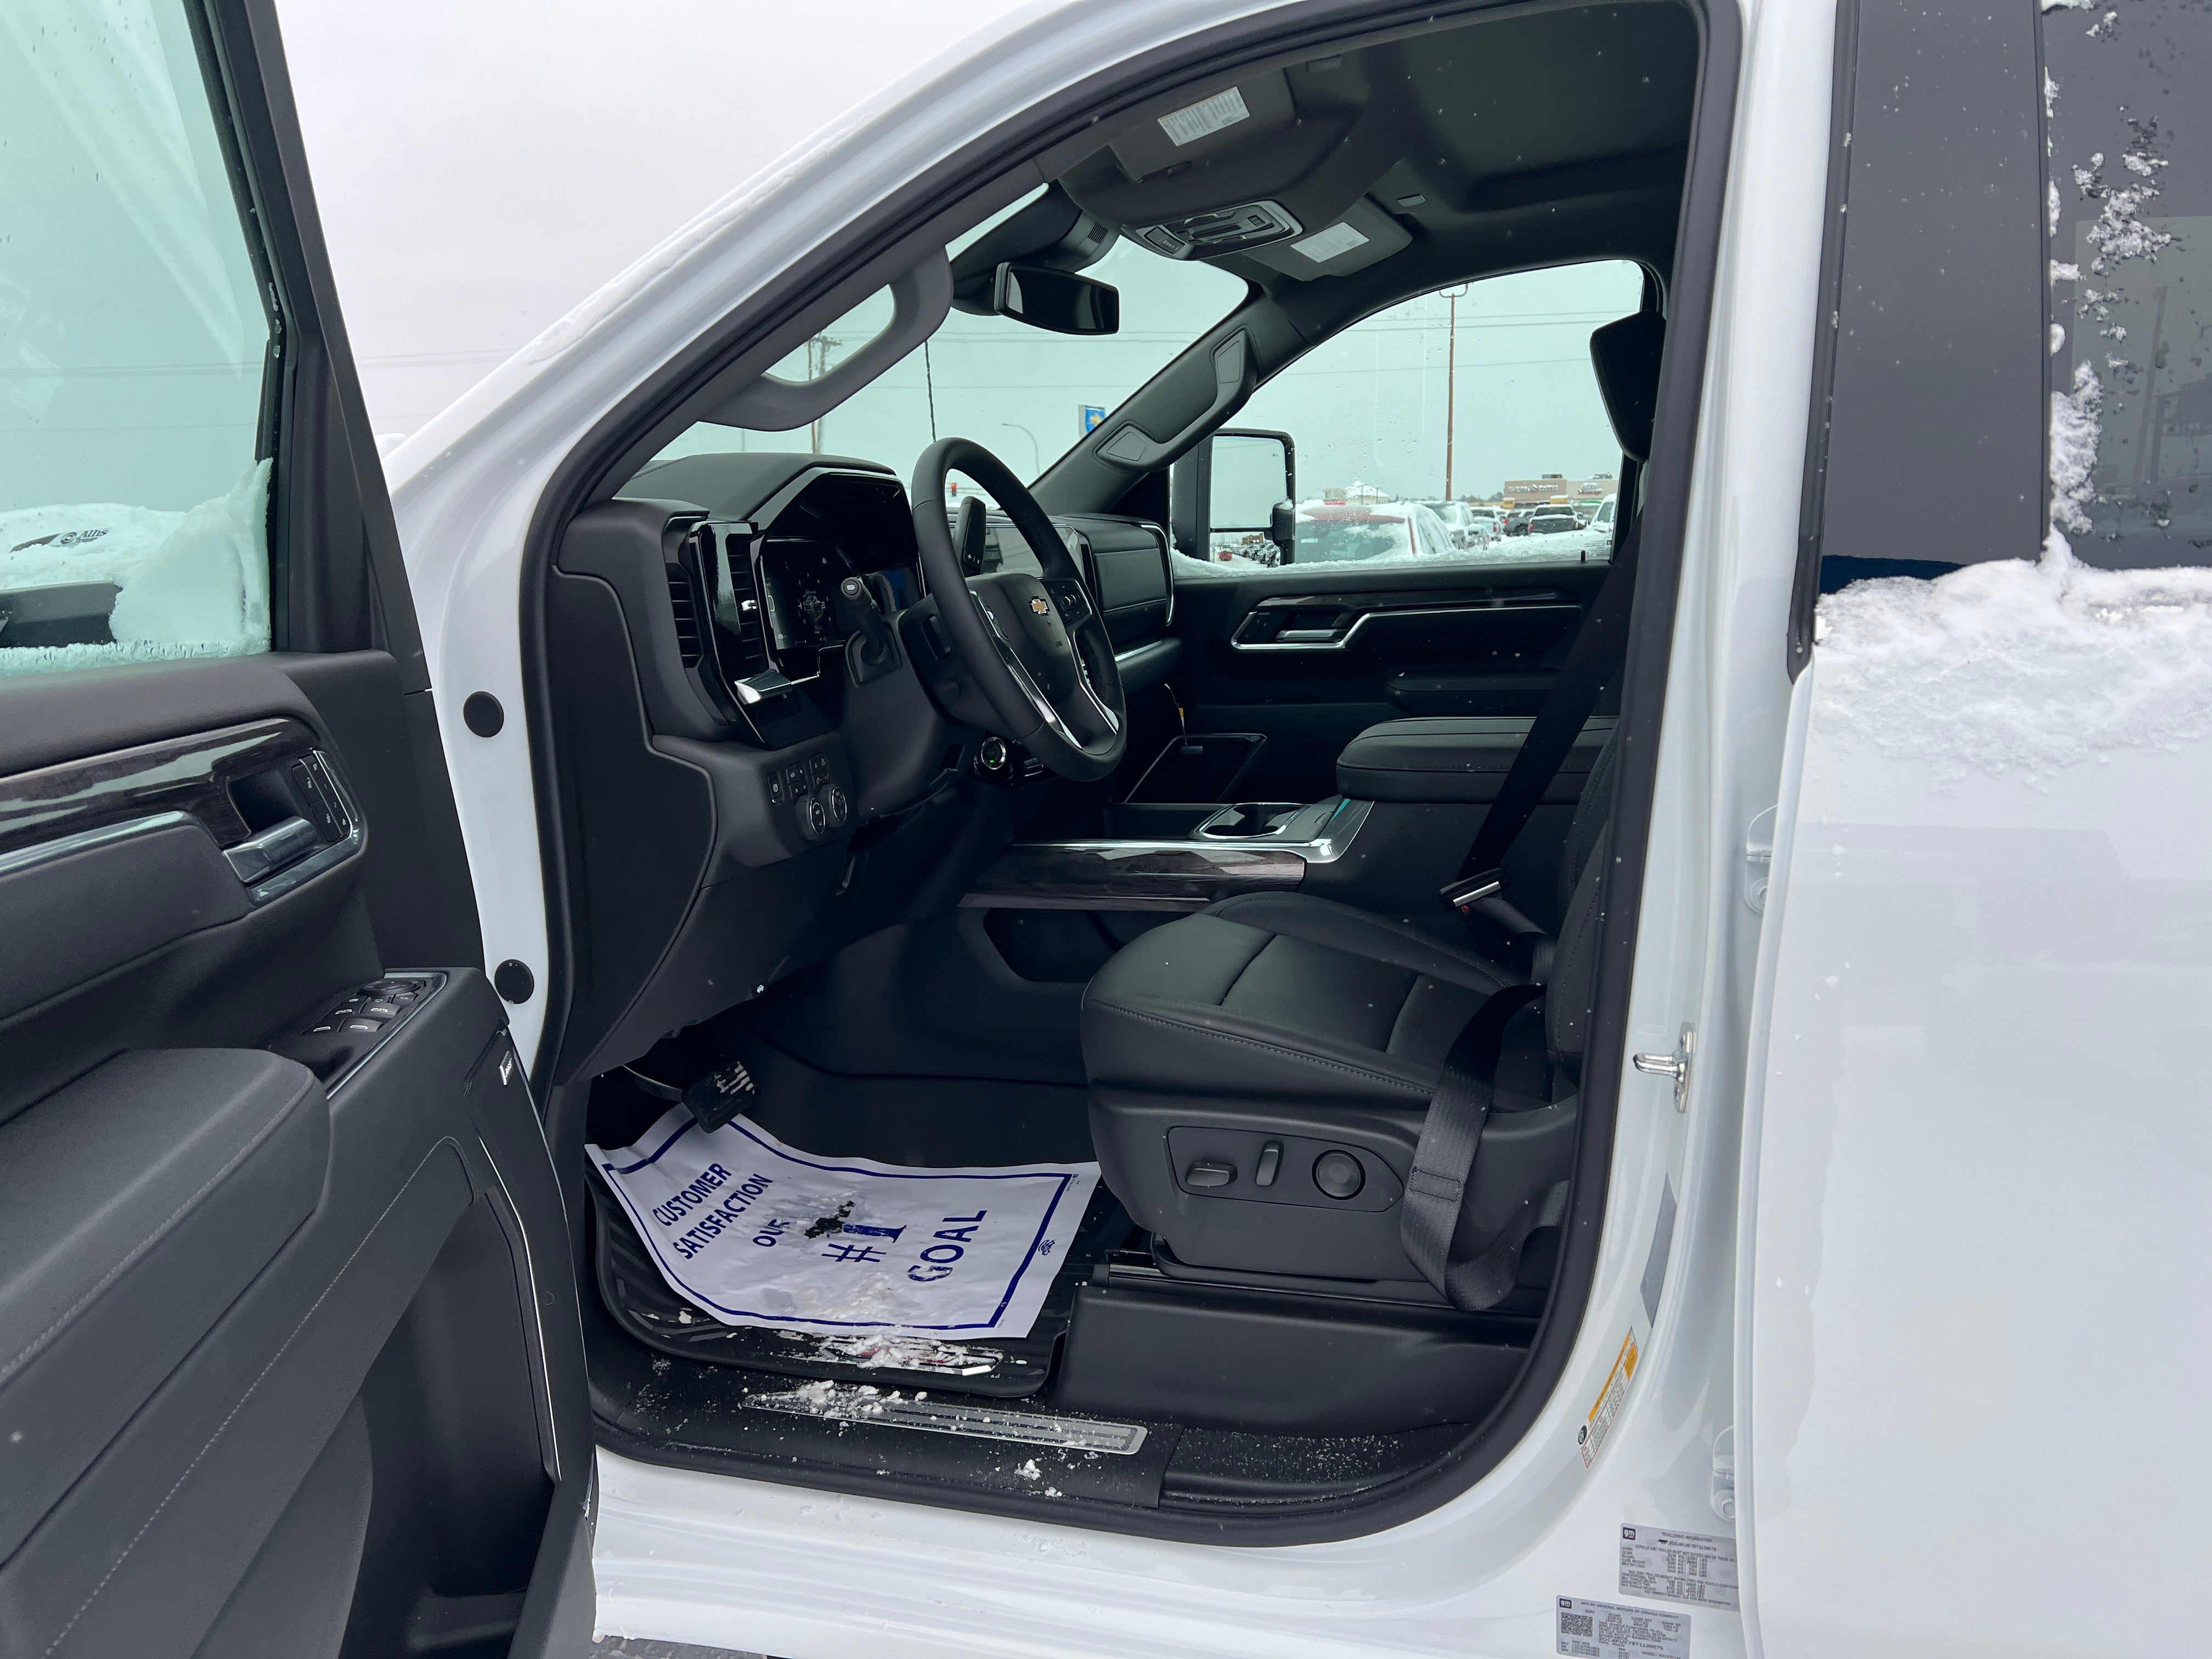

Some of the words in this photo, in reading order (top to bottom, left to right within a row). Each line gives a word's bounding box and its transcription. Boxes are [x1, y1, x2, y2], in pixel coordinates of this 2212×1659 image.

[78, 529, 110, 538] Allis
[653, 1163, 732, 1226] CUSTOMER
[673, 1173, 774, 1259] SATISFACTION
[907, 1210, 988, 1282] GOAL
